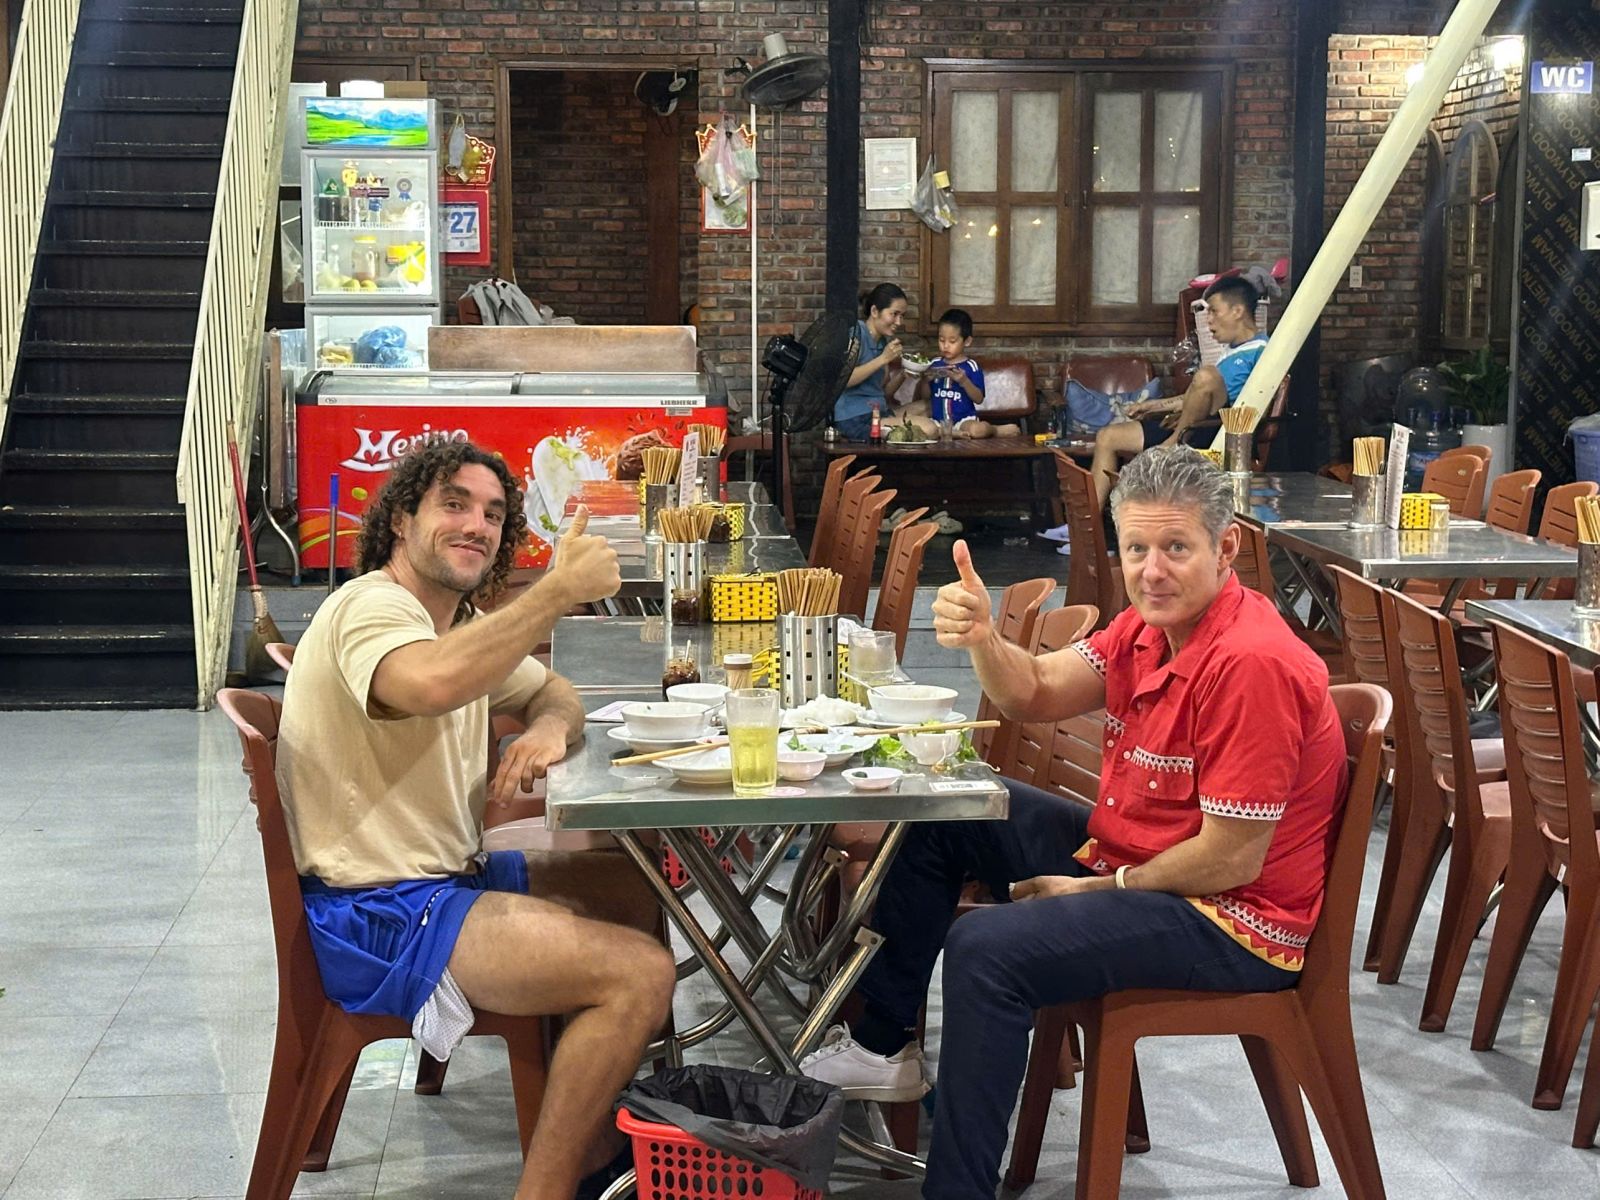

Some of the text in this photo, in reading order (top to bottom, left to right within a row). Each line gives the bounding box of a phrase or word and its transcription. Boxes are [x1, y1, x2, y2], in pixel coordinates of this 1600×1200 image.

[1540, 66, 1585, 88] WC
[1530, 131, 1581, 189] PLYWOOD
[450, 212, 476, 233] 27
[1531, 234, 1577, 287] VIETNAM
[1520, 270, 1552, 306] VIETN
[1523, 324, 1573, 382] PLYWOOD
[1548, 305, 1597, 361] PLYWOOD
[934, 388, 961, 401] Jeep
[352, 423, 469, 461] Merino
[1522, 424, 1568, 477] VIETNAM
